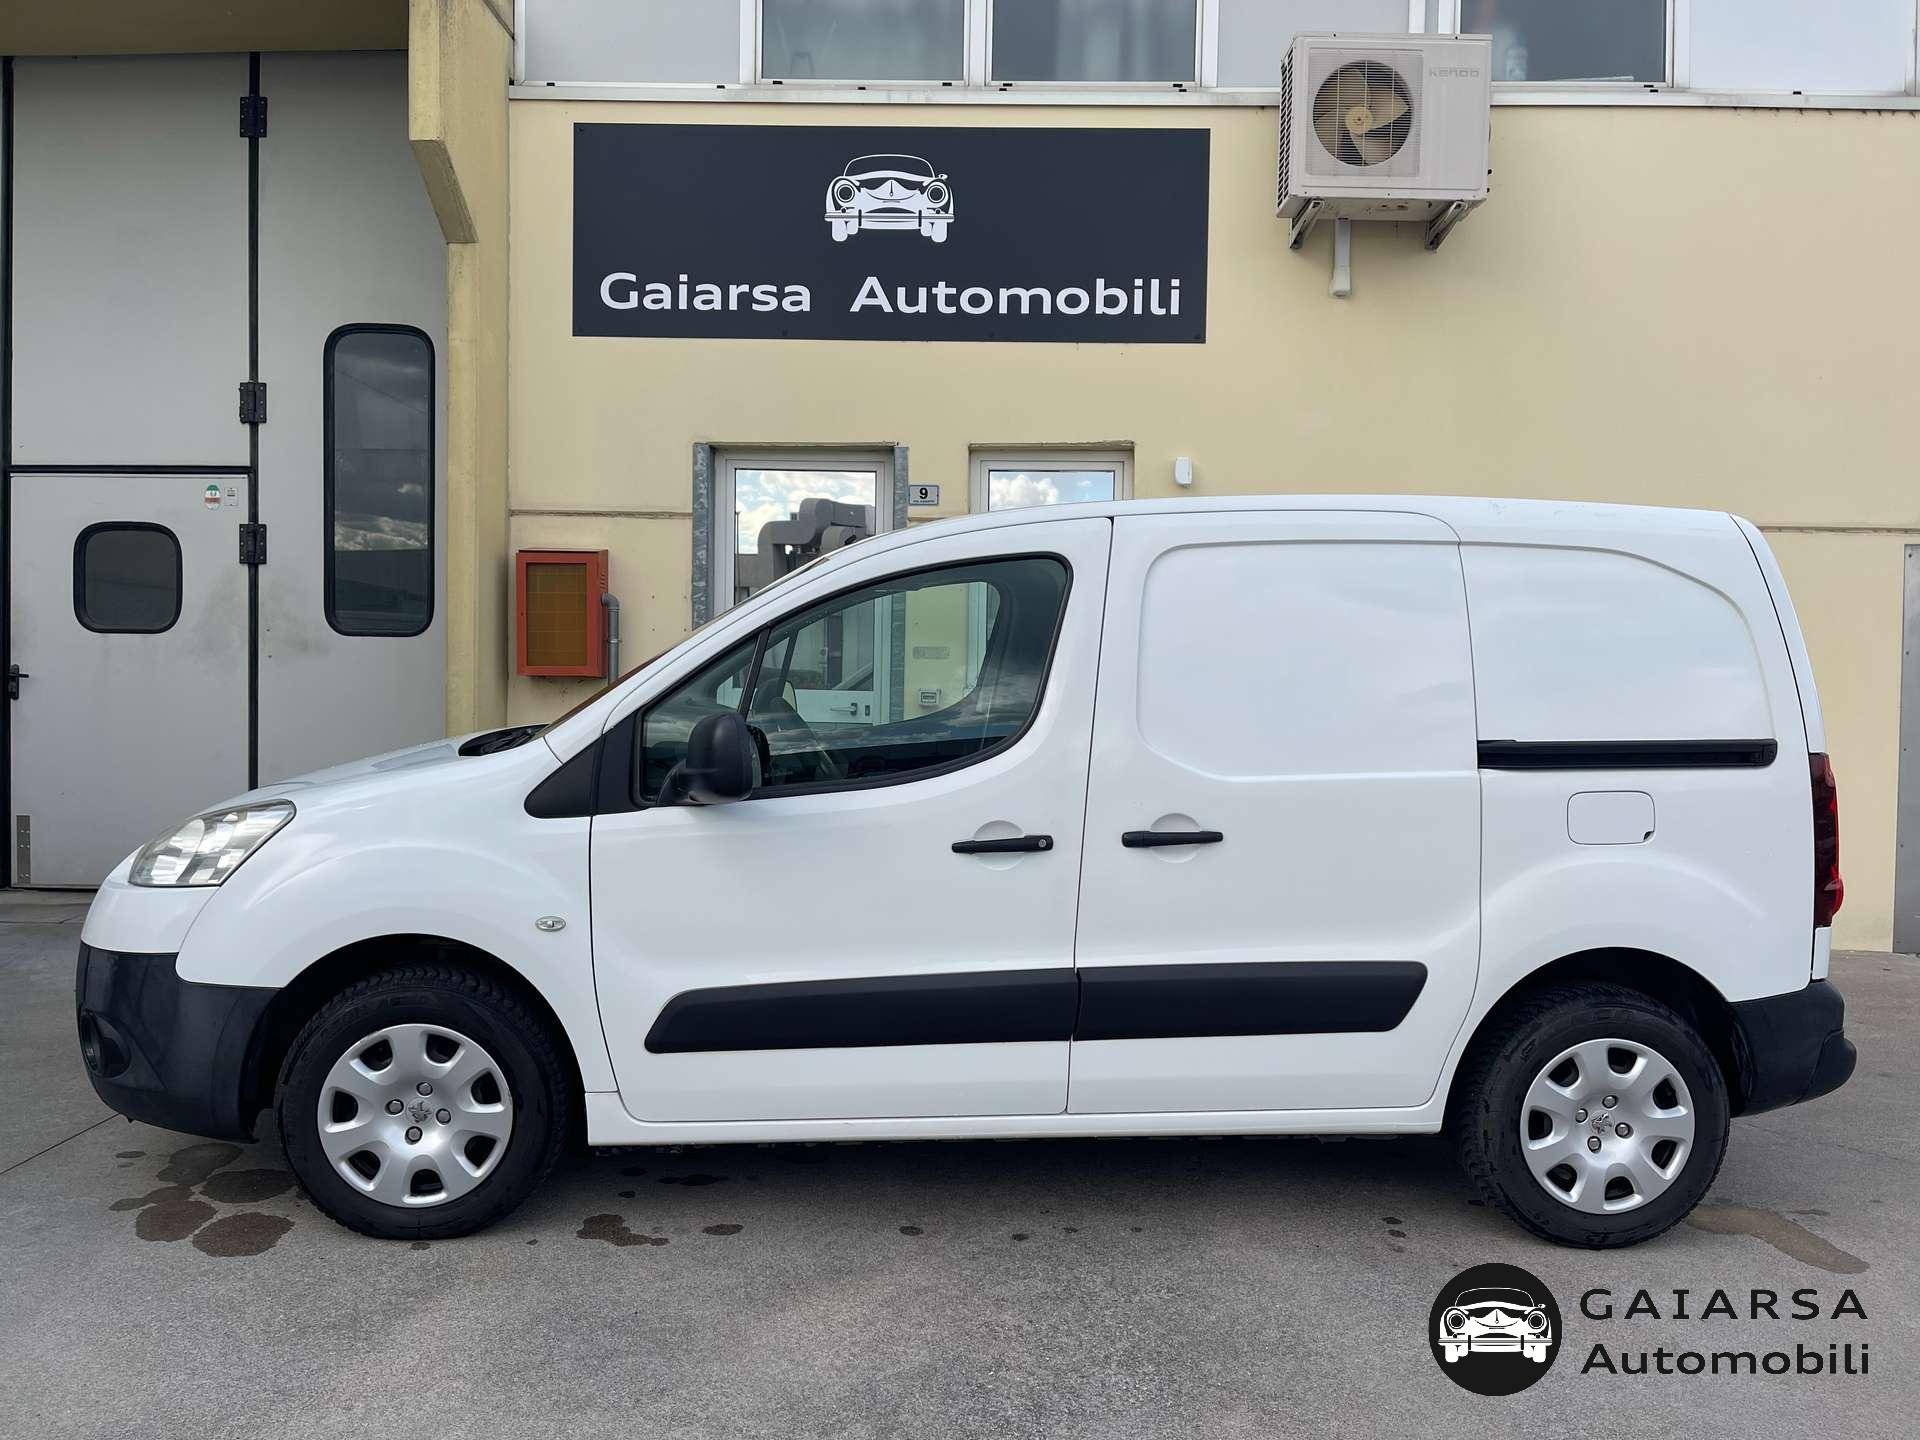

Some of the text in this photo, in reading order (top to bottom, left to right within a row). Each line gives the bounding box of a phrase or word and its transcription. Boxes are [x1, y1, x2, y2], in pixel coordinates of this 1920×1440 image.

[600, 272, 1181, 316] Gaiarsa Automobili
[919, 487, 928, 500] 9
